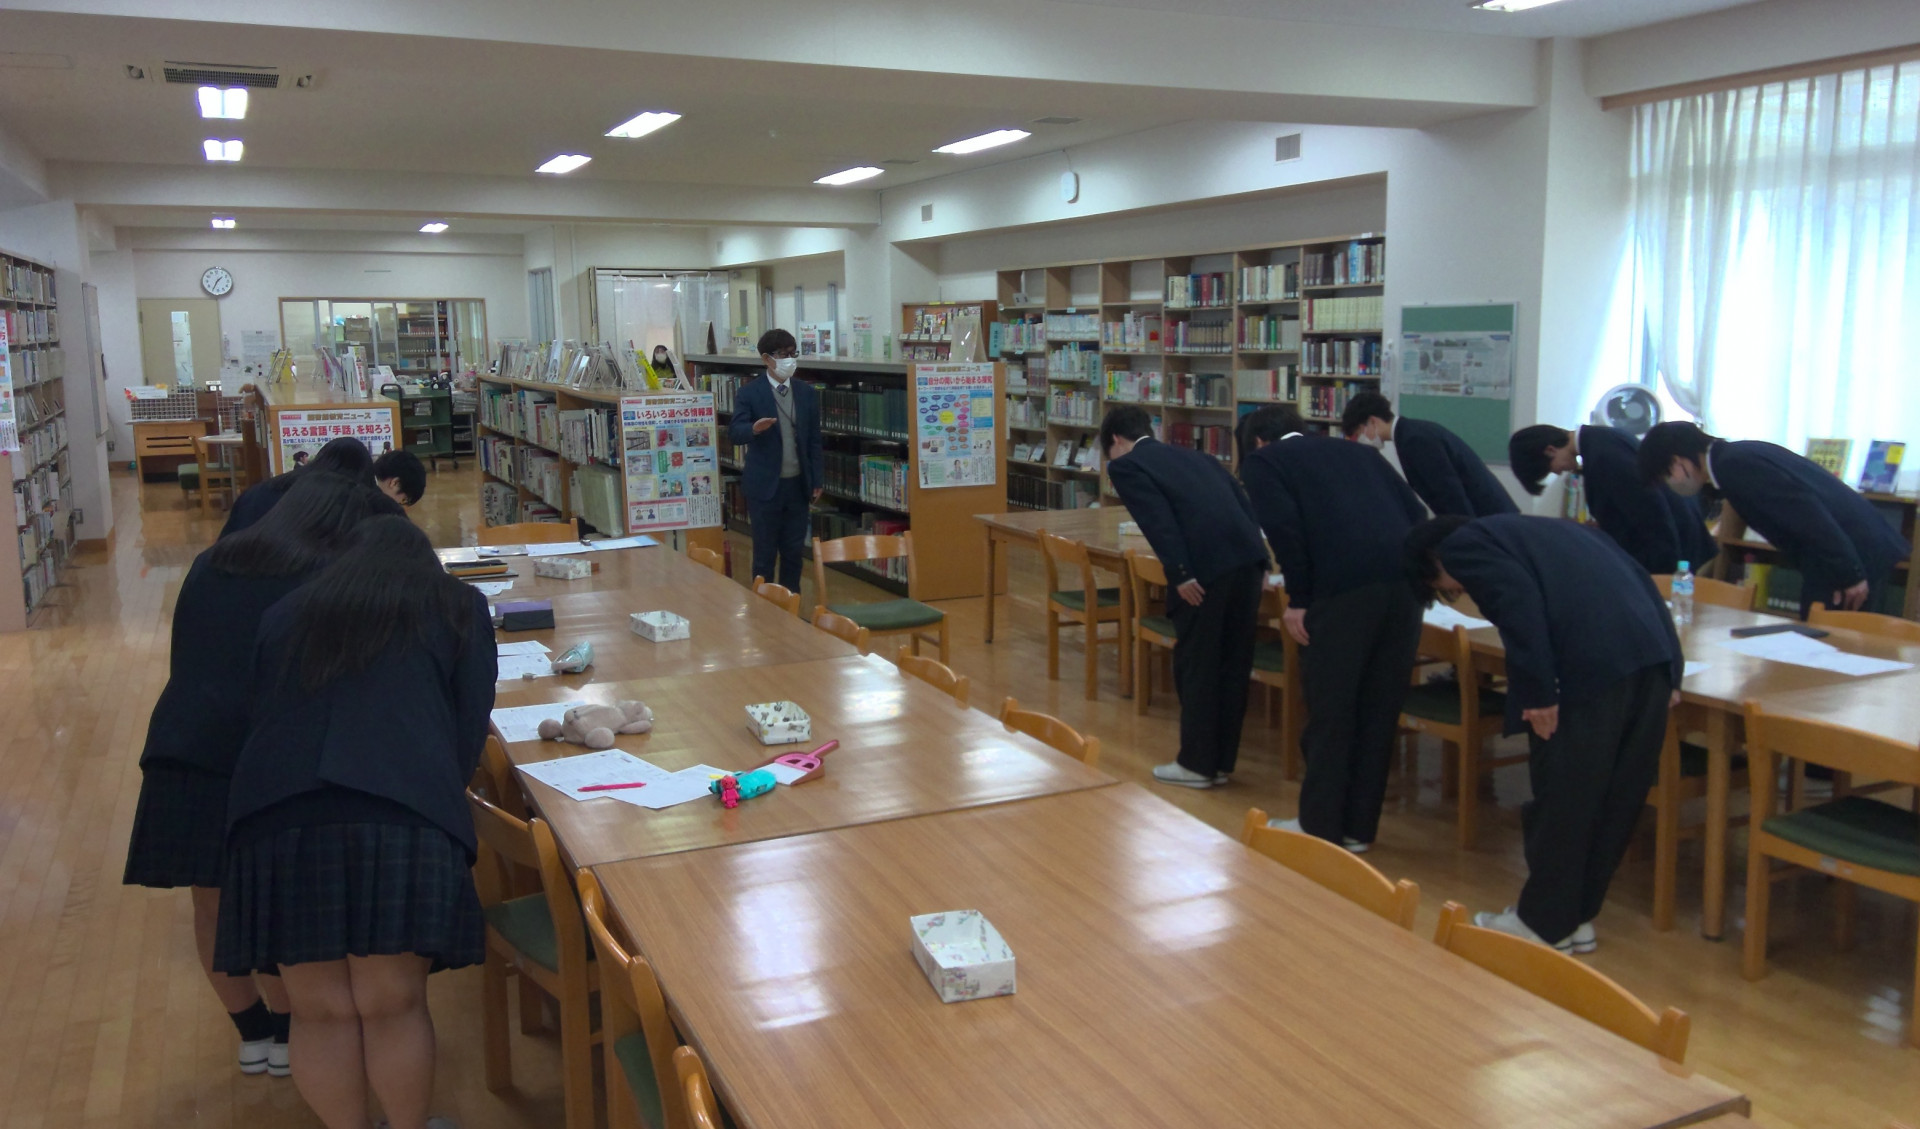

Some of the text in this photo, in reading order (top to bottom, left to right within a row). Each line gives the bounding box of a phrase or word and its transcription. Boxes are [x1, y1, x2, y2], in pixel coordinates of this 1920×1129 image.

[636, 407, 713, 419] いろいろ選べる情報源
[282, 424, 392, 437] 見える言語「手話」を知ろう
